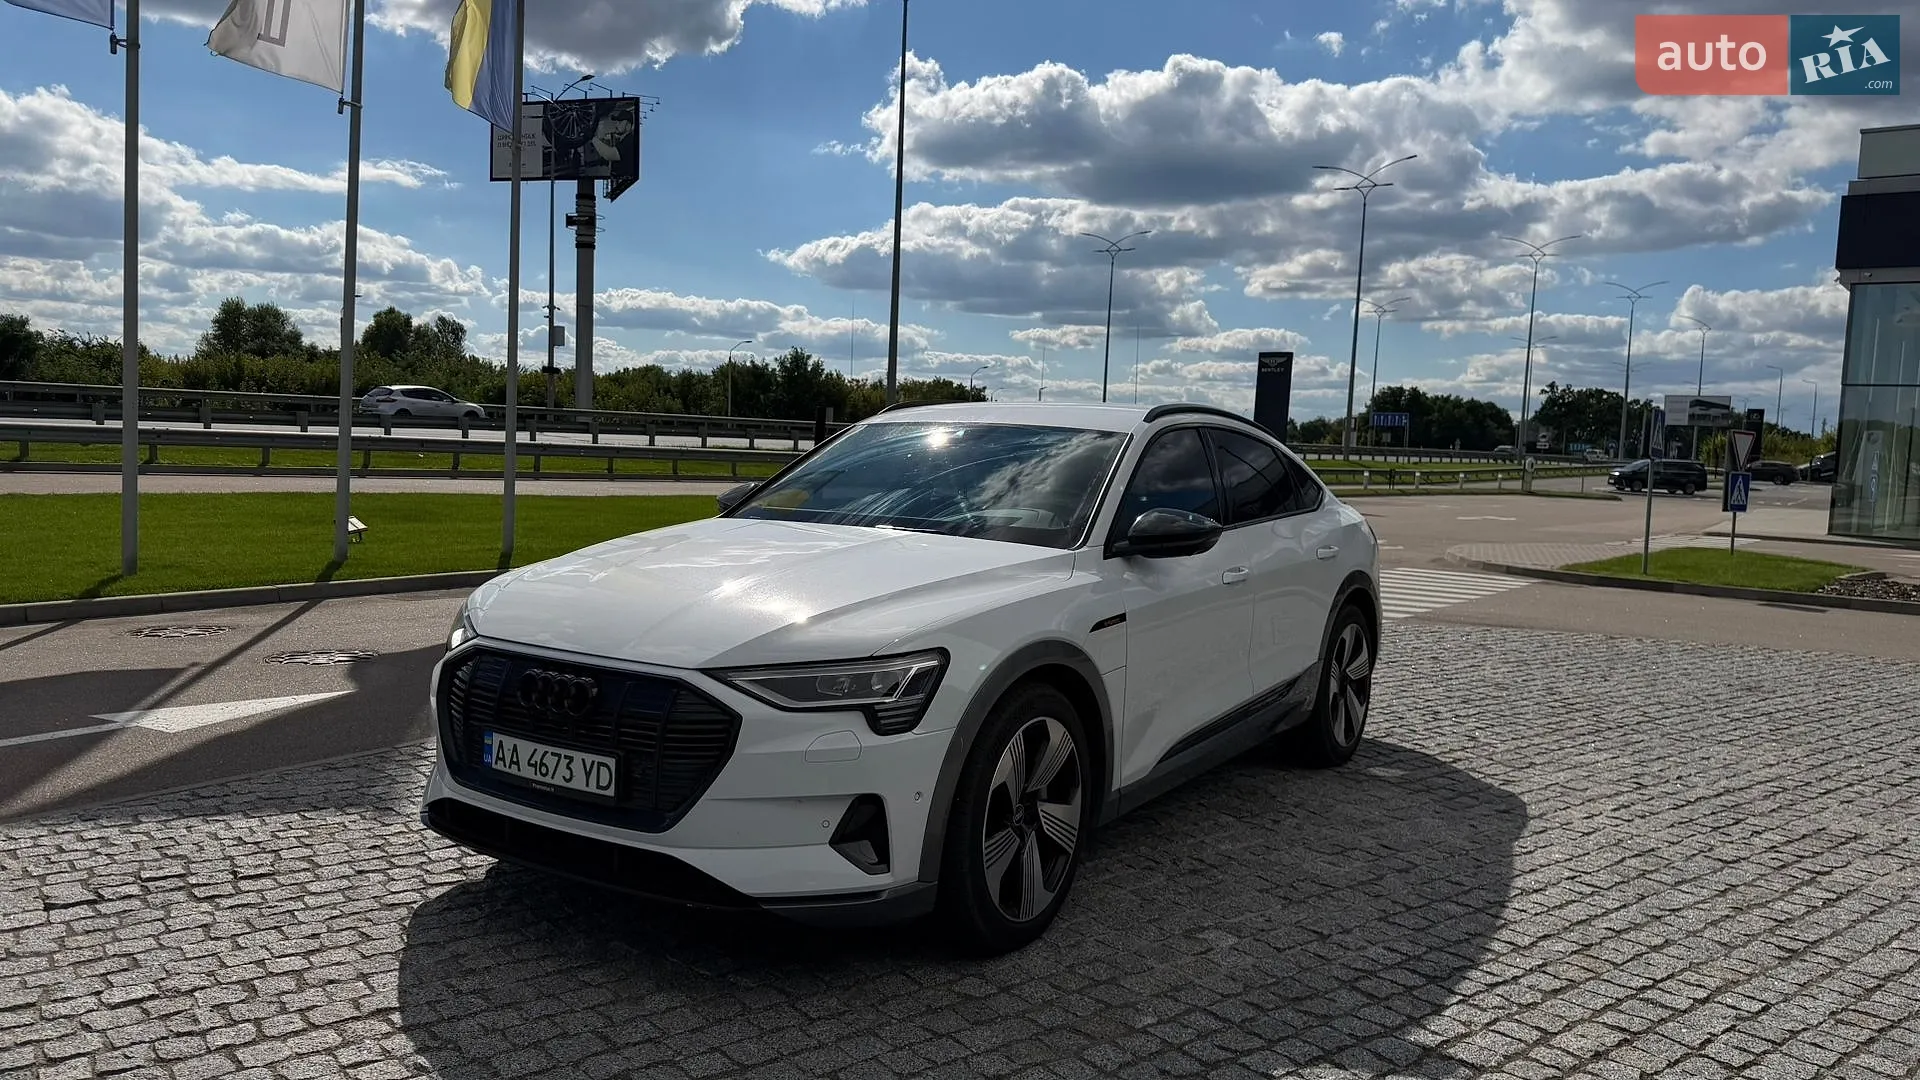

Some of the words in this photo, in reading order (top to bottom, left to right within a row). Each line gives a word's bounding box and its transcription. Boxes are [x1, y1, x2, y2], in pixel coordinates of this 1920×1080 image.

[483, 752, 492, 764] UA
[494, 739, 522, 772] AA
[527, 748, 575, 783] 4673
[581, 757, 613, 791] YD
